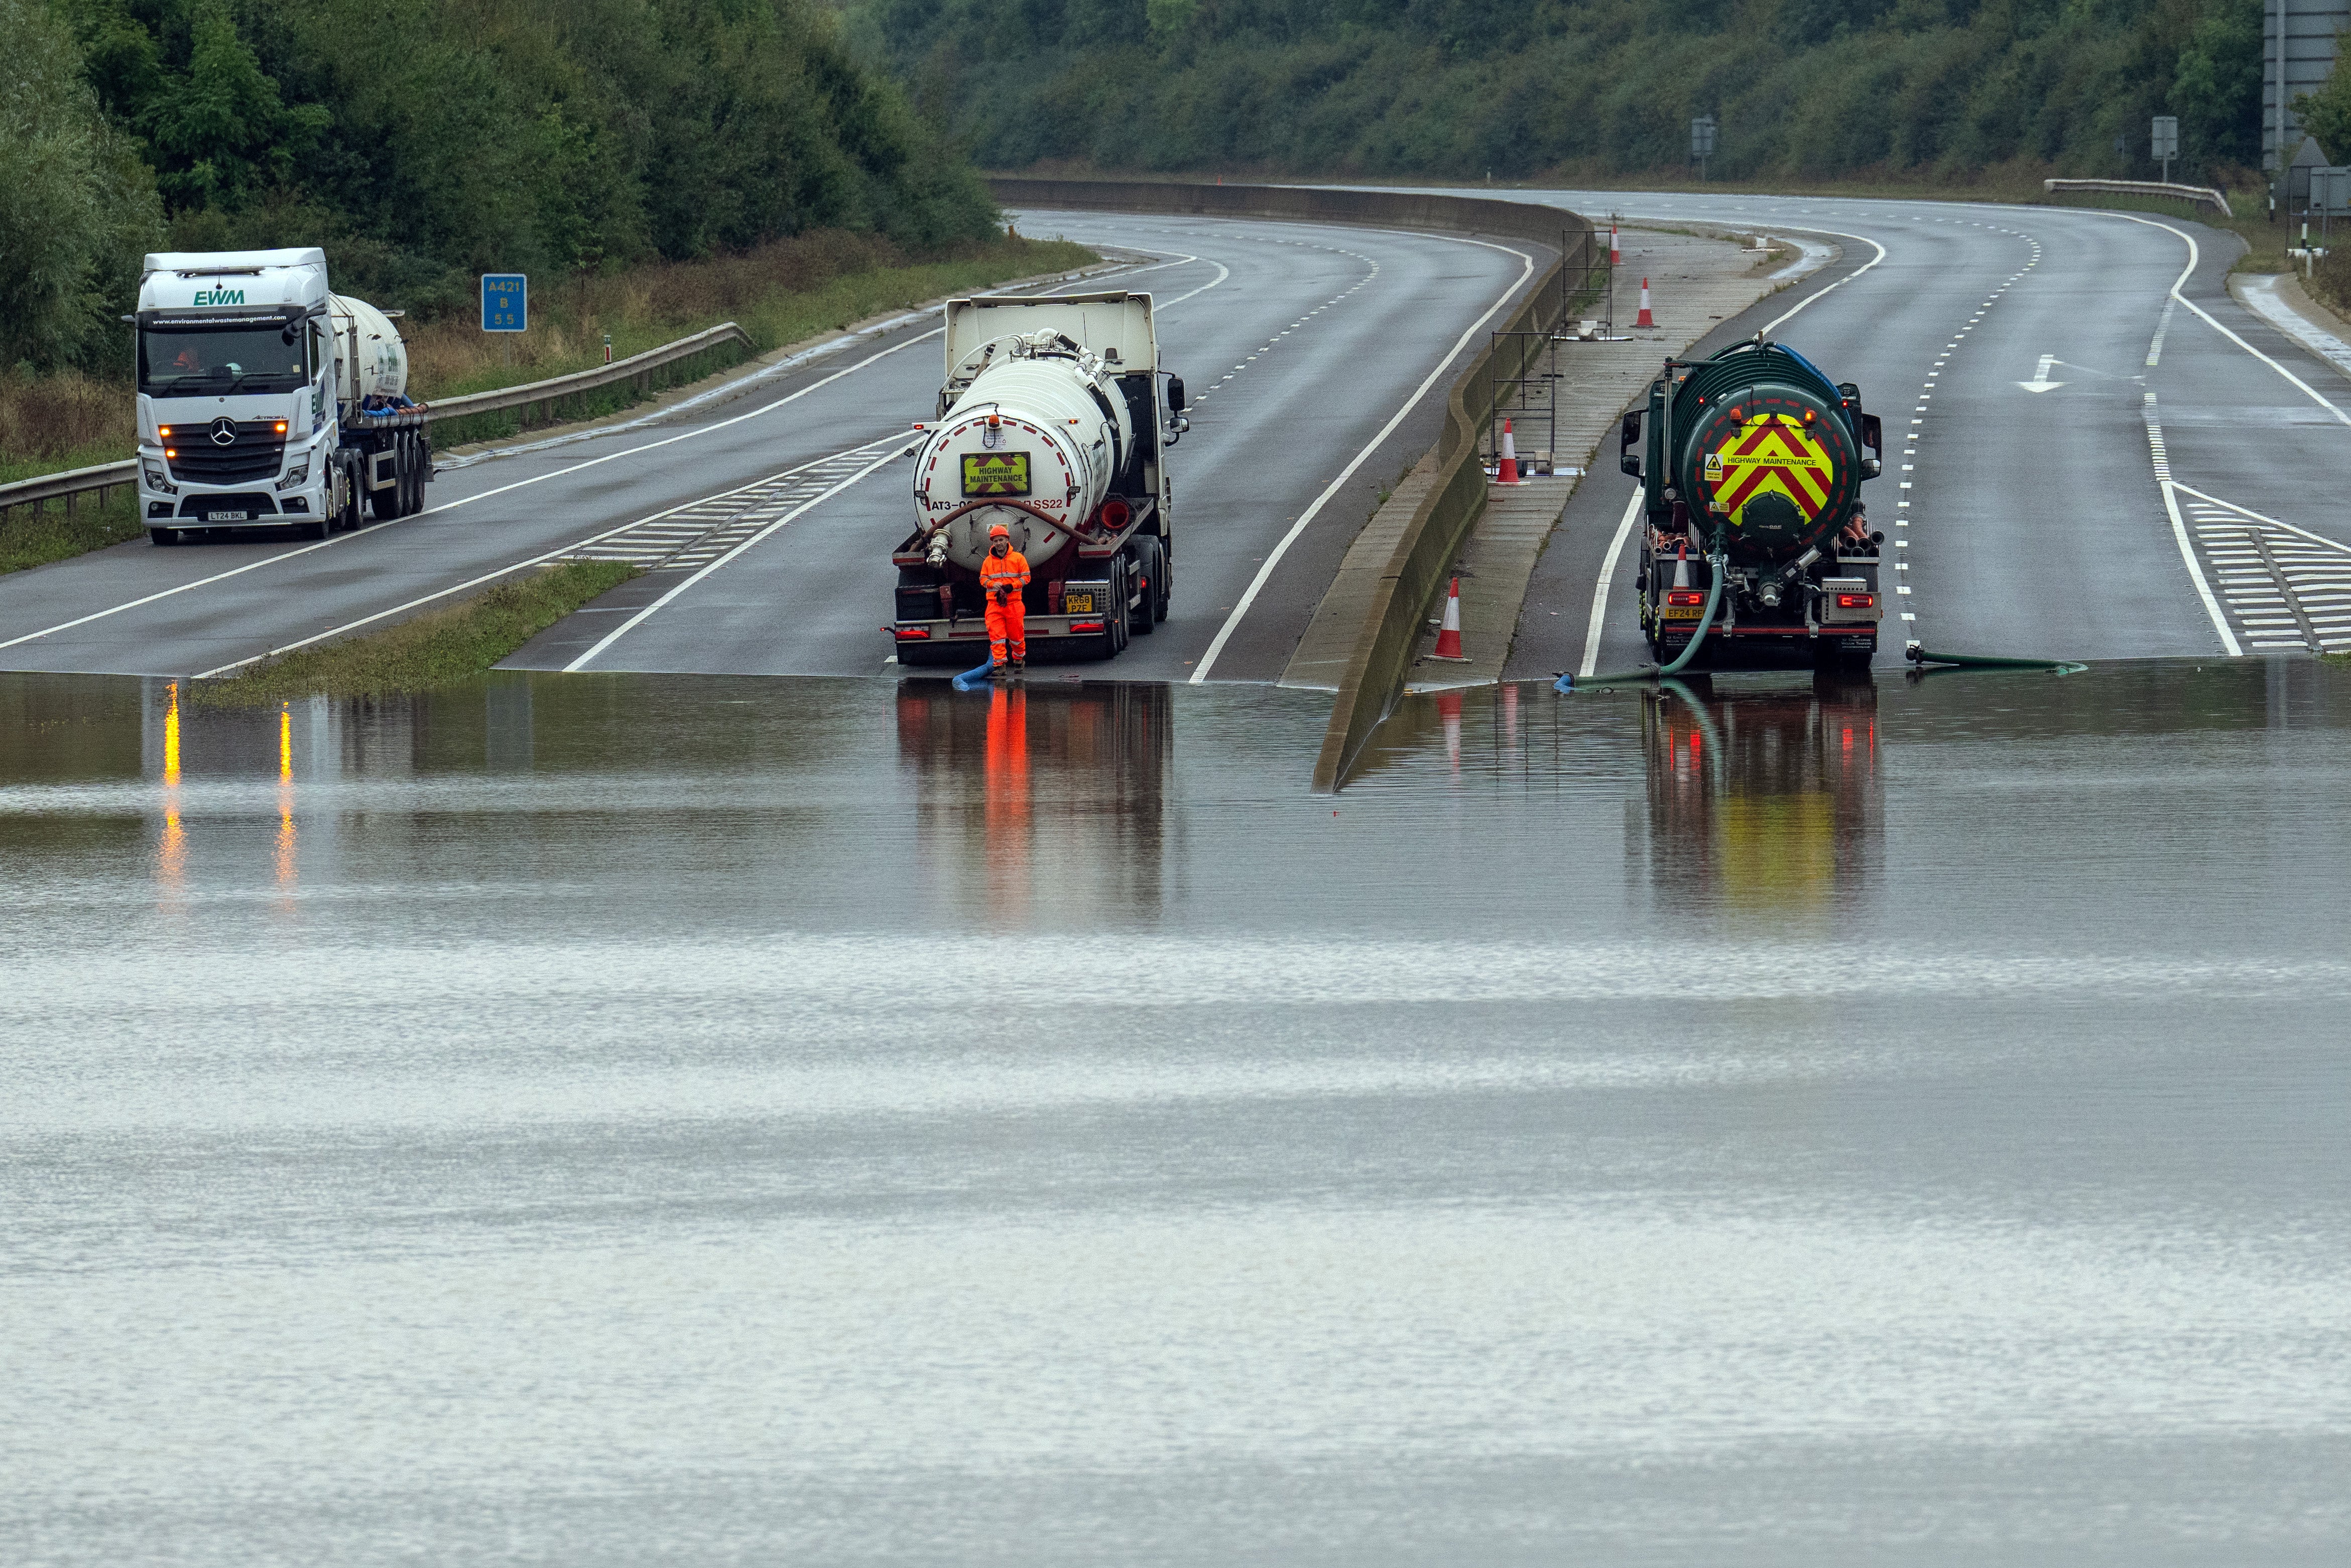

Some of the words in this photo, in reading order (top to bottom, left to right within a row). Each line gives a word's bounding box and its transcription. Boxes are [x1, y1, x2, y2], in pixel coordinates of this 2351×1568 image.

[489, 281, 519, 292] A421
[193, 290, 244, 306] EWM
[500, 297, 508, 308] B
[153, 315, 287, 324] www.environmentalwastemanagement.com
[1763, 458, 1816, 466] MAINTENANCE
[970, 474, 1023, 483] MAINTENANCE
[1668, 609, 1689, 617] EF24
